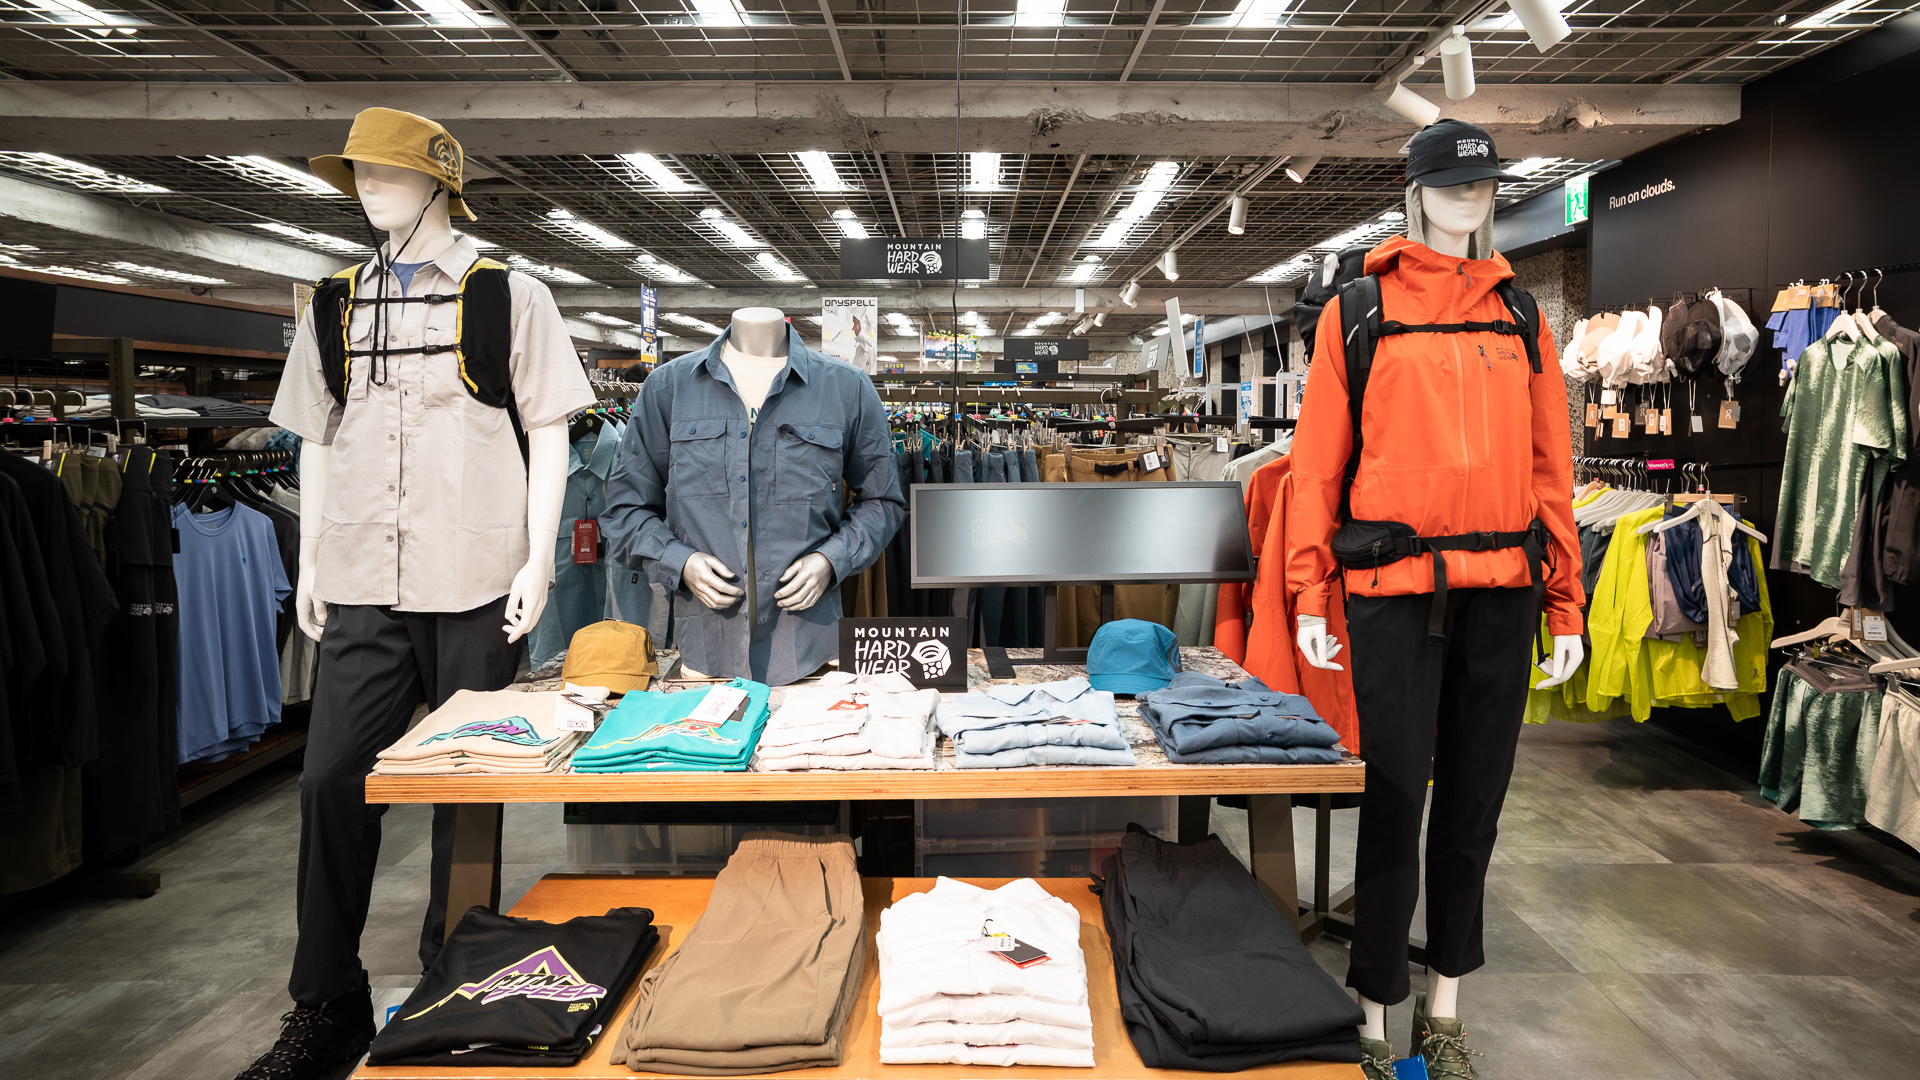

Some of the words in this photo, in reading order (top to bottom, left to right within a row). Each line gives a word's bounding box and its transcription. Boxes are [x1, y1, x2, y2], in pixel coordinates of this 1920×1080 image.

[1457, 149, 1478, 157] WEAR
[1609, 195, 1626, 210] Run
[1627, 191, 1640, 204] on
[1640, 178, 1676, 200] clouds.
[887, 250, 919, 263] HARD
[887, 262, 920, 274] WEAR
[971, 517, 1027, 525] MOUNTAIN
[971, 525, 1003, 536] HARD
[971, 536, 1004, 547] WEAR
[854, 627, 950, 638] MOUNTAIN
[854, 639, 911, 660] HARD
[854, 659, 912, 679] WEAR
